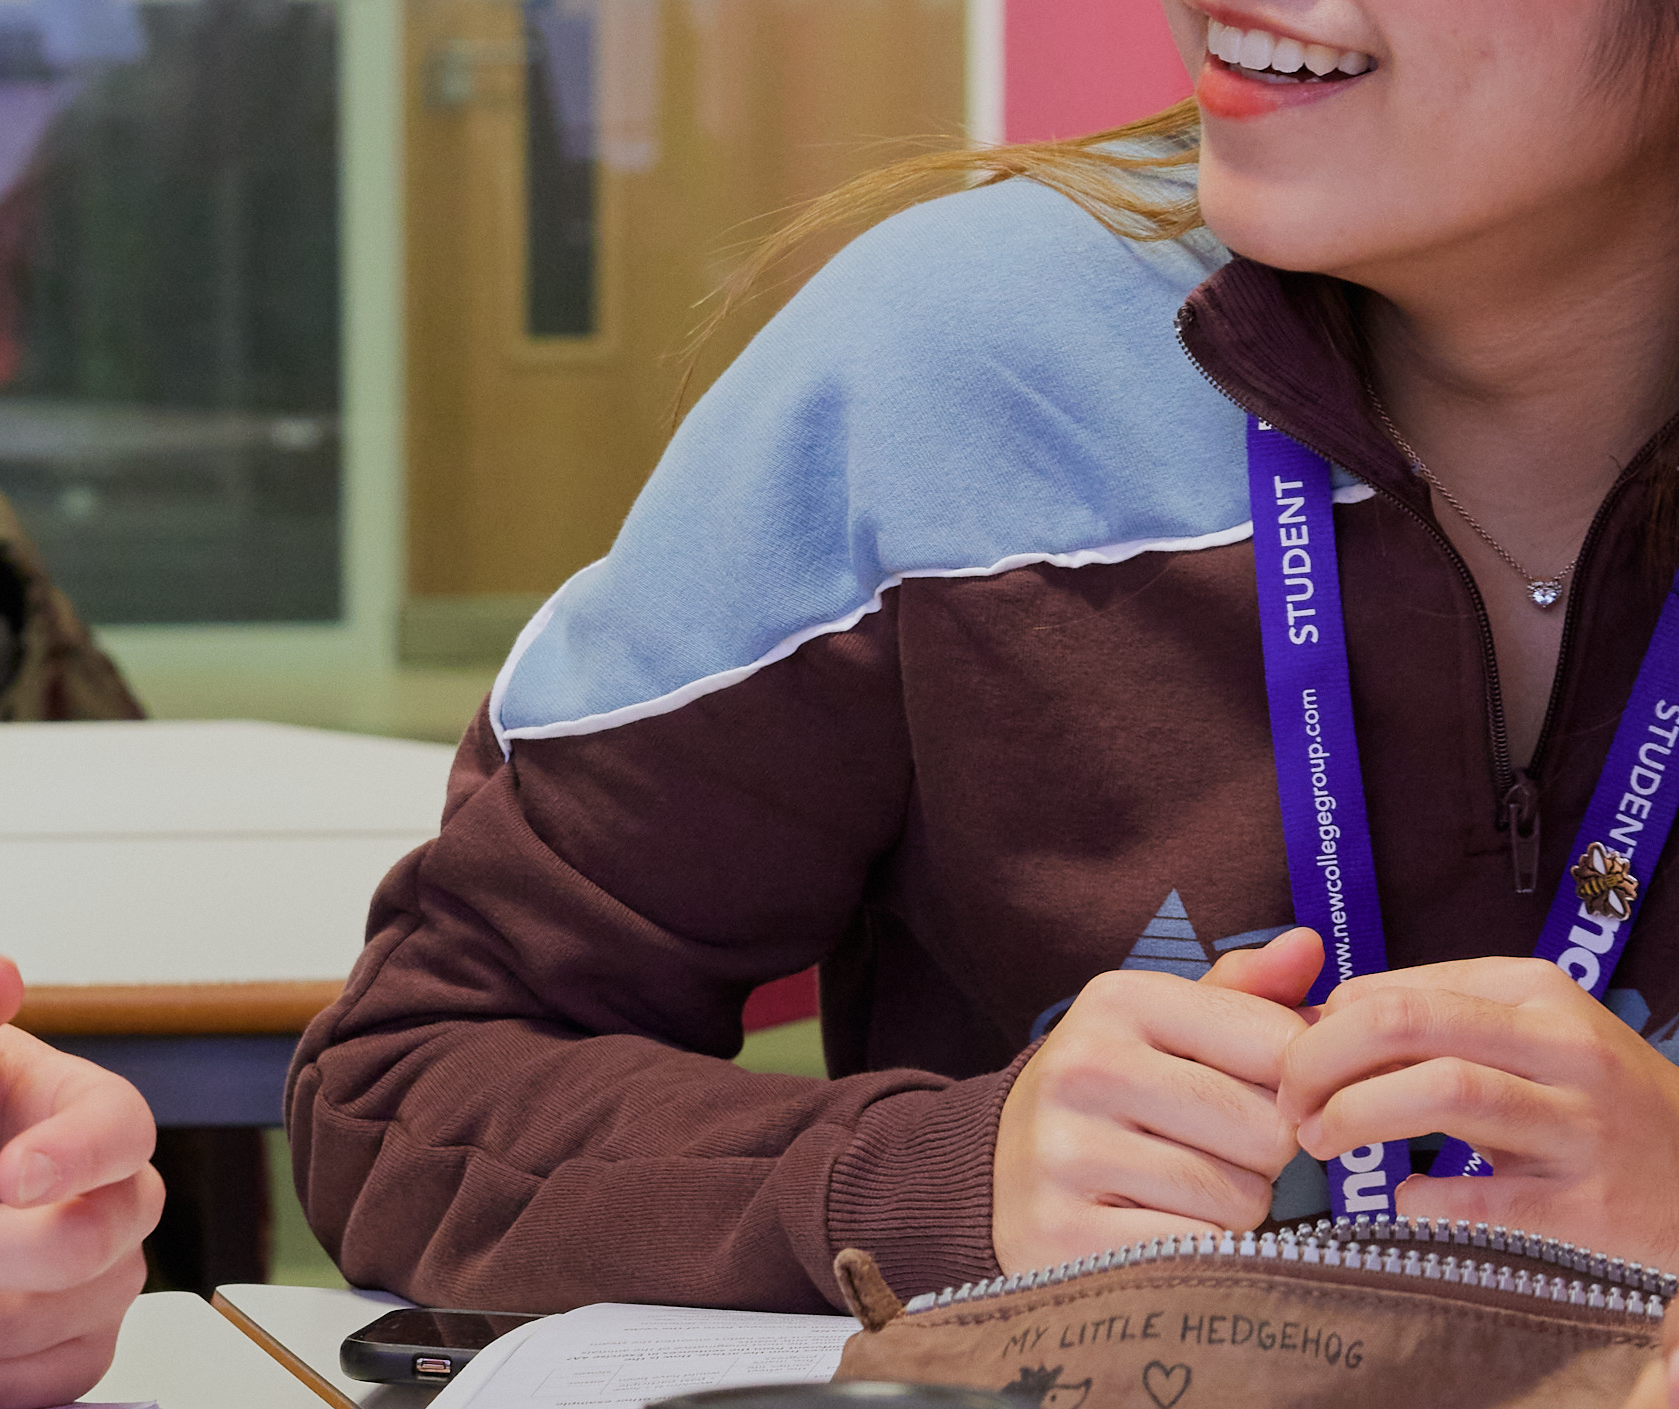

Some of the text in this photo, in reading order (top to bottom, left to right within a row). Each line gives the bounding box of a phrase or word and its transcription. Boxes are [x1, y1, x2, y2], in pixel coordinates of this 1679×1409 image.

[1274, 475, 1319, 645] STUDENT
[1302, 688, 1354, 983] ww.newcollegegroup.com
[1556, 898, 1621, 993] nc
[1339, 1142, 1390, 1214] nc
[1002, 1311, 1364, 1369] MY LITTLE HEDGEHOG
